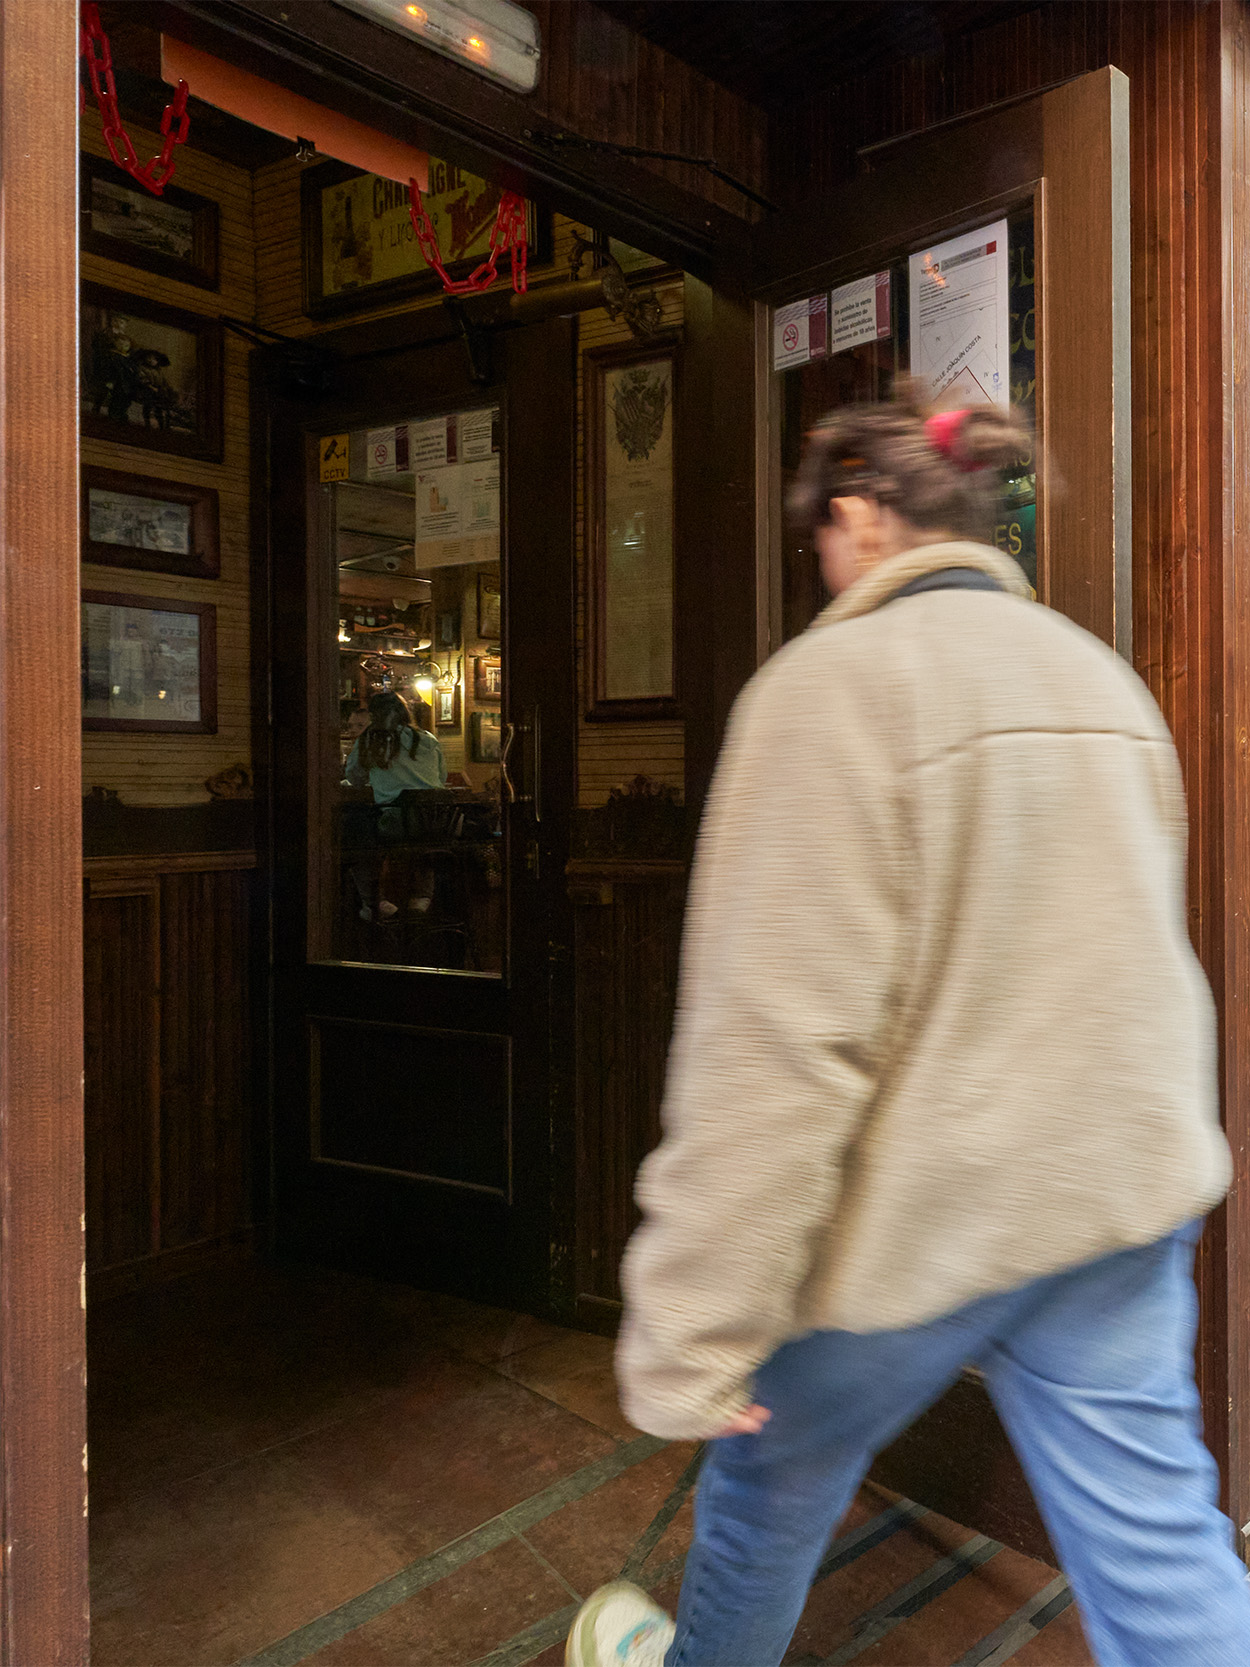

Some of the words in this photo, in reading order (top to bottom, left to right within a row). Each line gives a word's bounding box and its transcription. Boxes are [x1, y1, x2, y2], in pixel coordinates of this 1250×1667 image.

[932, 369, 947, 387] CALLE
[965, 334, 982, 353] COSTA
[323, 467, 347, 481] CCTV
